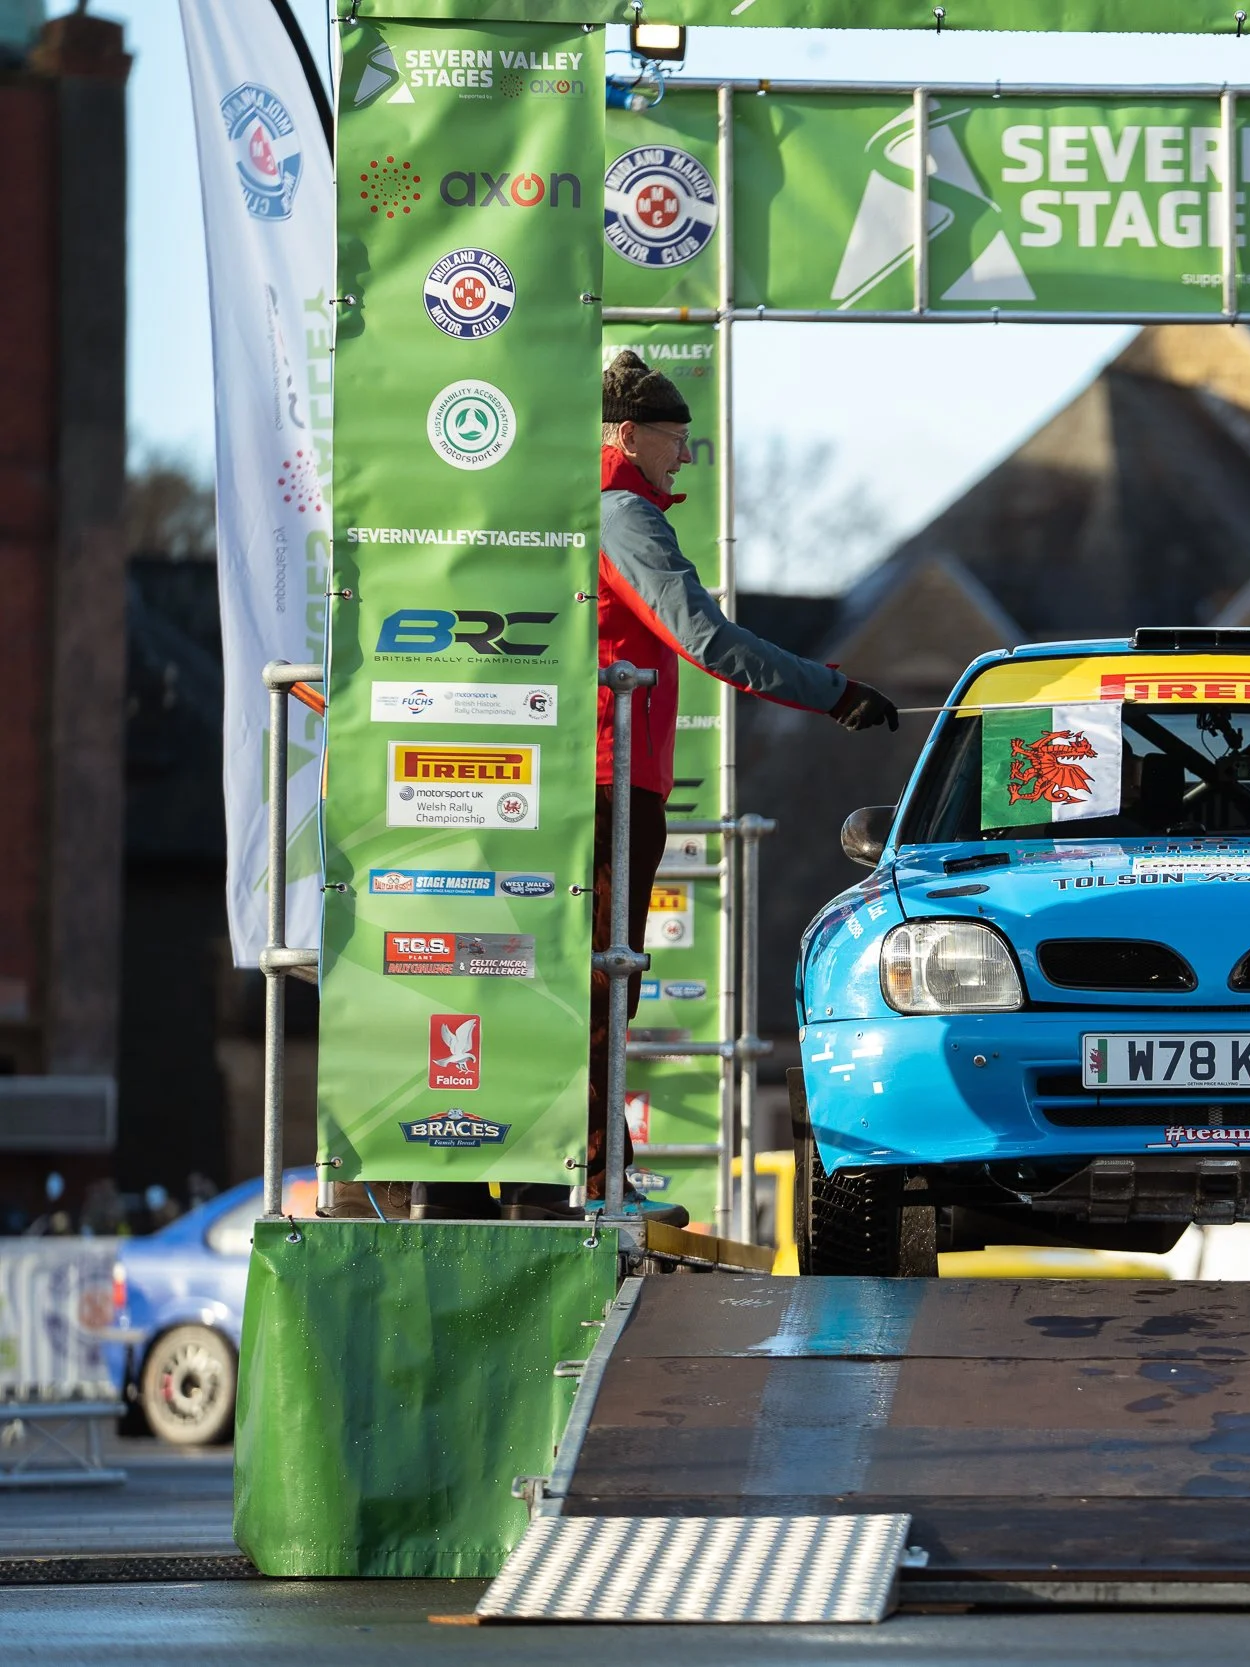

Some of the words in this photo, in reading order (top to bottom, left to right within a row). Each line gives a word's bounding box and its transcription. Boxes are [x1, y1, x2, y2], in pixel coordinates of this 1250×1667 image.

[405, 50, 492, 68] SEVERN
[500, 51, 583, 70] VALLEY
[410, 69, 493, 88] STAGES
[530, 78, 584, 94] axon
[606, 150, 664, 190] MIDLAND
[669, 154, 712, 198] MANOR
[440, 171, 580, 208] axon
[606, 222, 649, 262] MOTOR
[661, 236, 700, 264] CLUB
[432, 251, 475, 282] MIDLAND
[479, 254, 510, 288] MANOR
[430, 305, 462, 335] MOTOR
[472, 315, 500, 336] CLUB
[648, 344, 714, 360] VALLEY
[435, 388, 472, 436] SUSTAINABILITY
[474, 388, 508, 438] ACCREDITATION
[440, 440, 492, 464] motorsport
[347, 528, 586, 548] SEVERNVALLEYSTAGES.INFO
[375, 609, 559, 656] BRC
[426, 656, 462, 664] RALLY
[402, 698, 434, 706] FUCHS
[455, 692, 488, 700] motorsport
[404, 752, 522, 780] PIRELLI
[416, 790, 470, 798] motorsport
[417, 802, 446, 812] Welsh
[450, 802, 473, 813] Rally
[416, 814, 485, 824] Championship
[416, 876, 444, 888] STAGE
[446, 878, 490, 890] MASTERS
[1053, 872, 1185, 891] TOLSON
[393, 937, 450, 954] T.C.S.
[460, 962, 466, 971] &
[470, 960, 498, 968] CELTIC
[499, 960, 527, 968] MICRA
[470, 967, 528, 976] CHALLENGE
[1128, 1041, 1216, 1080] W78
[436, 1076, 472, 1086] Falcon
[411, 1121, 500, 1137] BRACE'S
